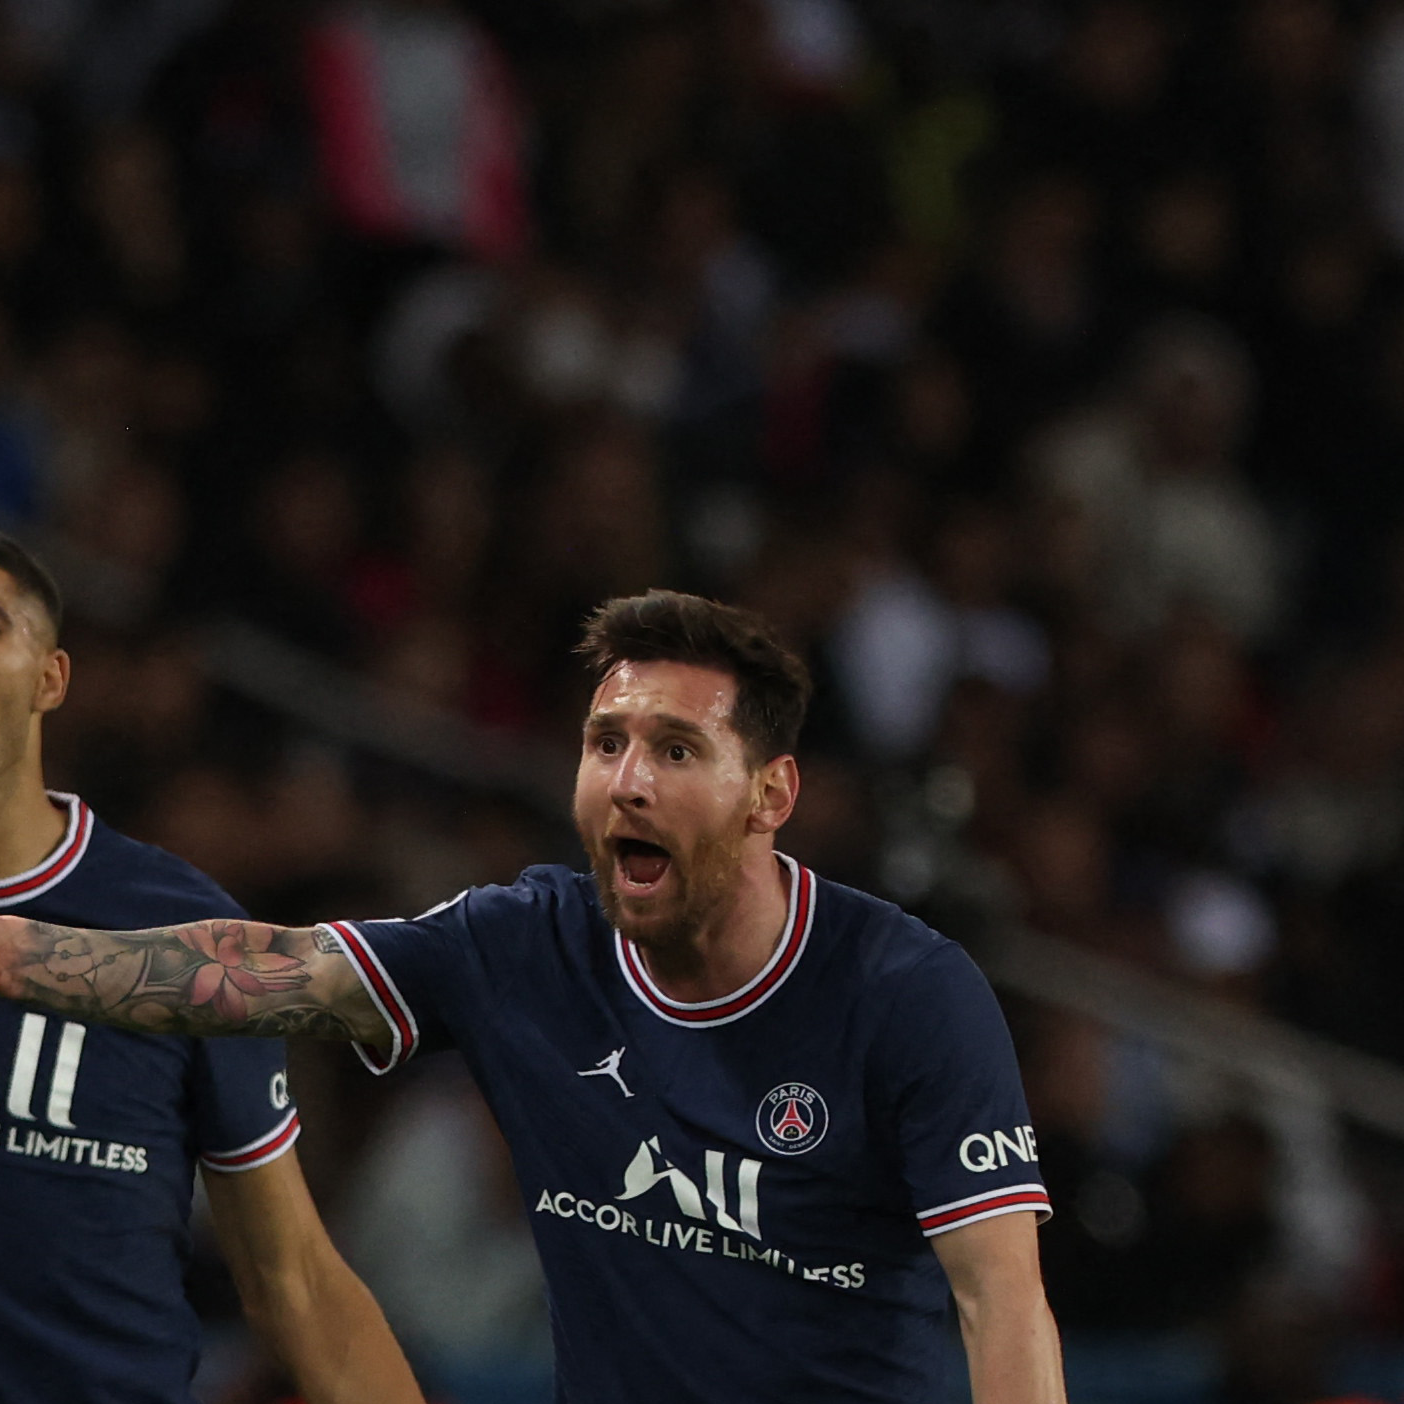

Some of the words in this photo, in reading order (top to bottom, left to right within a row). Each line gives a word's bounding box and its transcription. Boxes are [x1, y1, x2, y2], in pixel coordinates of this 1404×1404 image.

[768, 1086, 816, 1105] PARIS
[6, 1126, 149, 1174] LIMITLESS
[534, 1188, 640, 1237] ACCOR
[646, 1219, 714, 1254] LIVE
